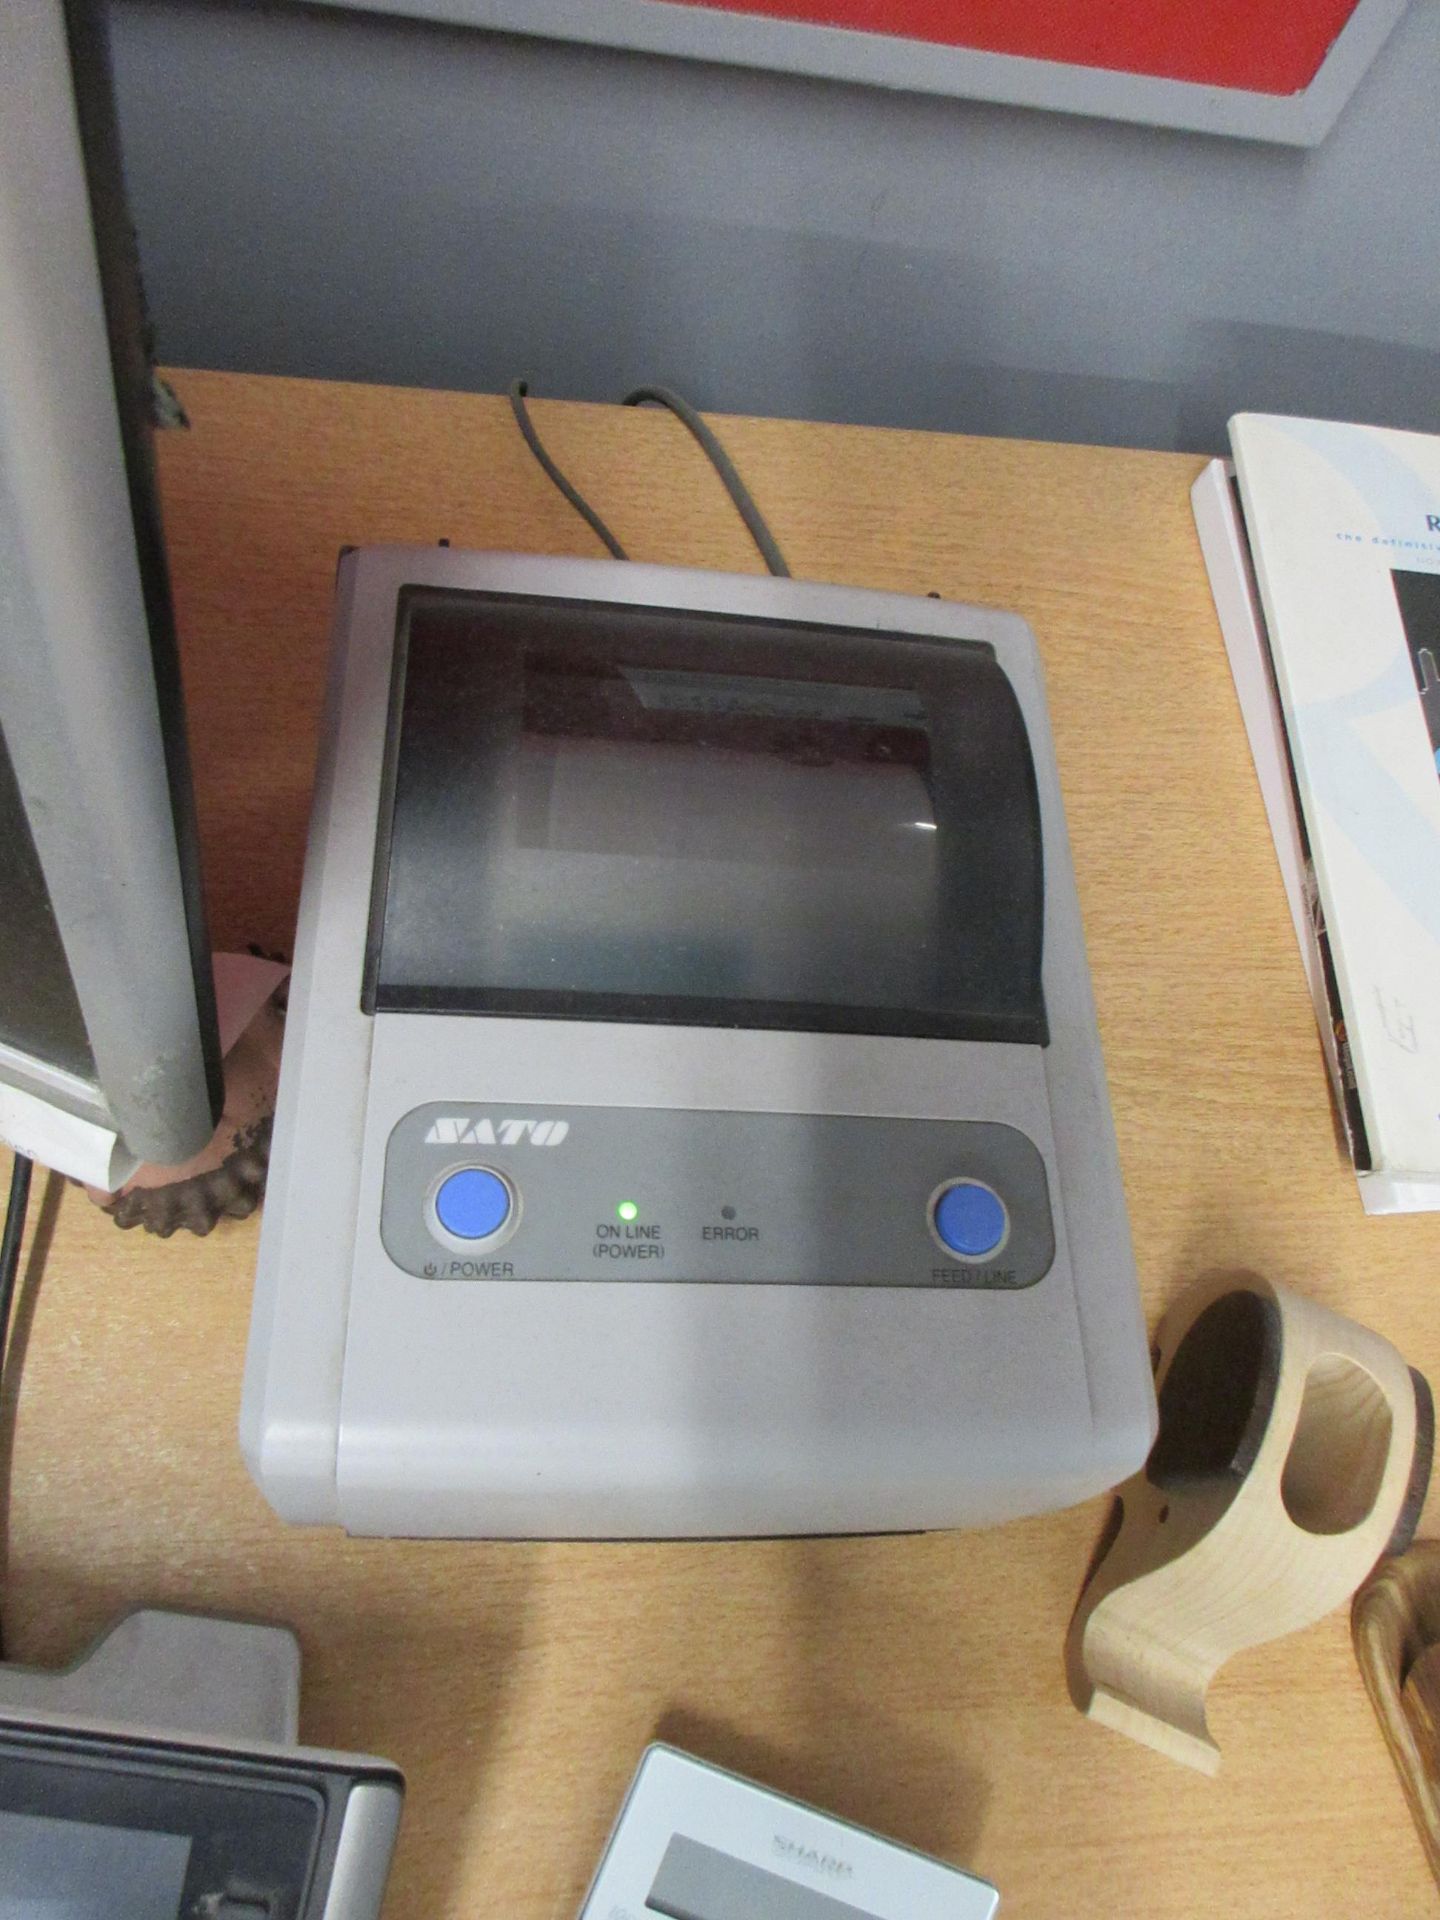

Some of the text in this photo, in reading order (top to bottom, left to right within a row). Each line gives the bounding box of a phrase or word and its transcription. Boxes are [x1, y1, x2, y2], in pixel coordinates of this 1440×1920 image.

[424, 1117, 569, 1146] SATO
[596, 1224, 662, 1239] ON LINE
[702, 1226, 759, 1241] ERROR
[592, 1243, 665, 1259] (POWER)
[450, 1262, 514, 1277] POWER
[774, 1835, 853, 1878] SHARP
